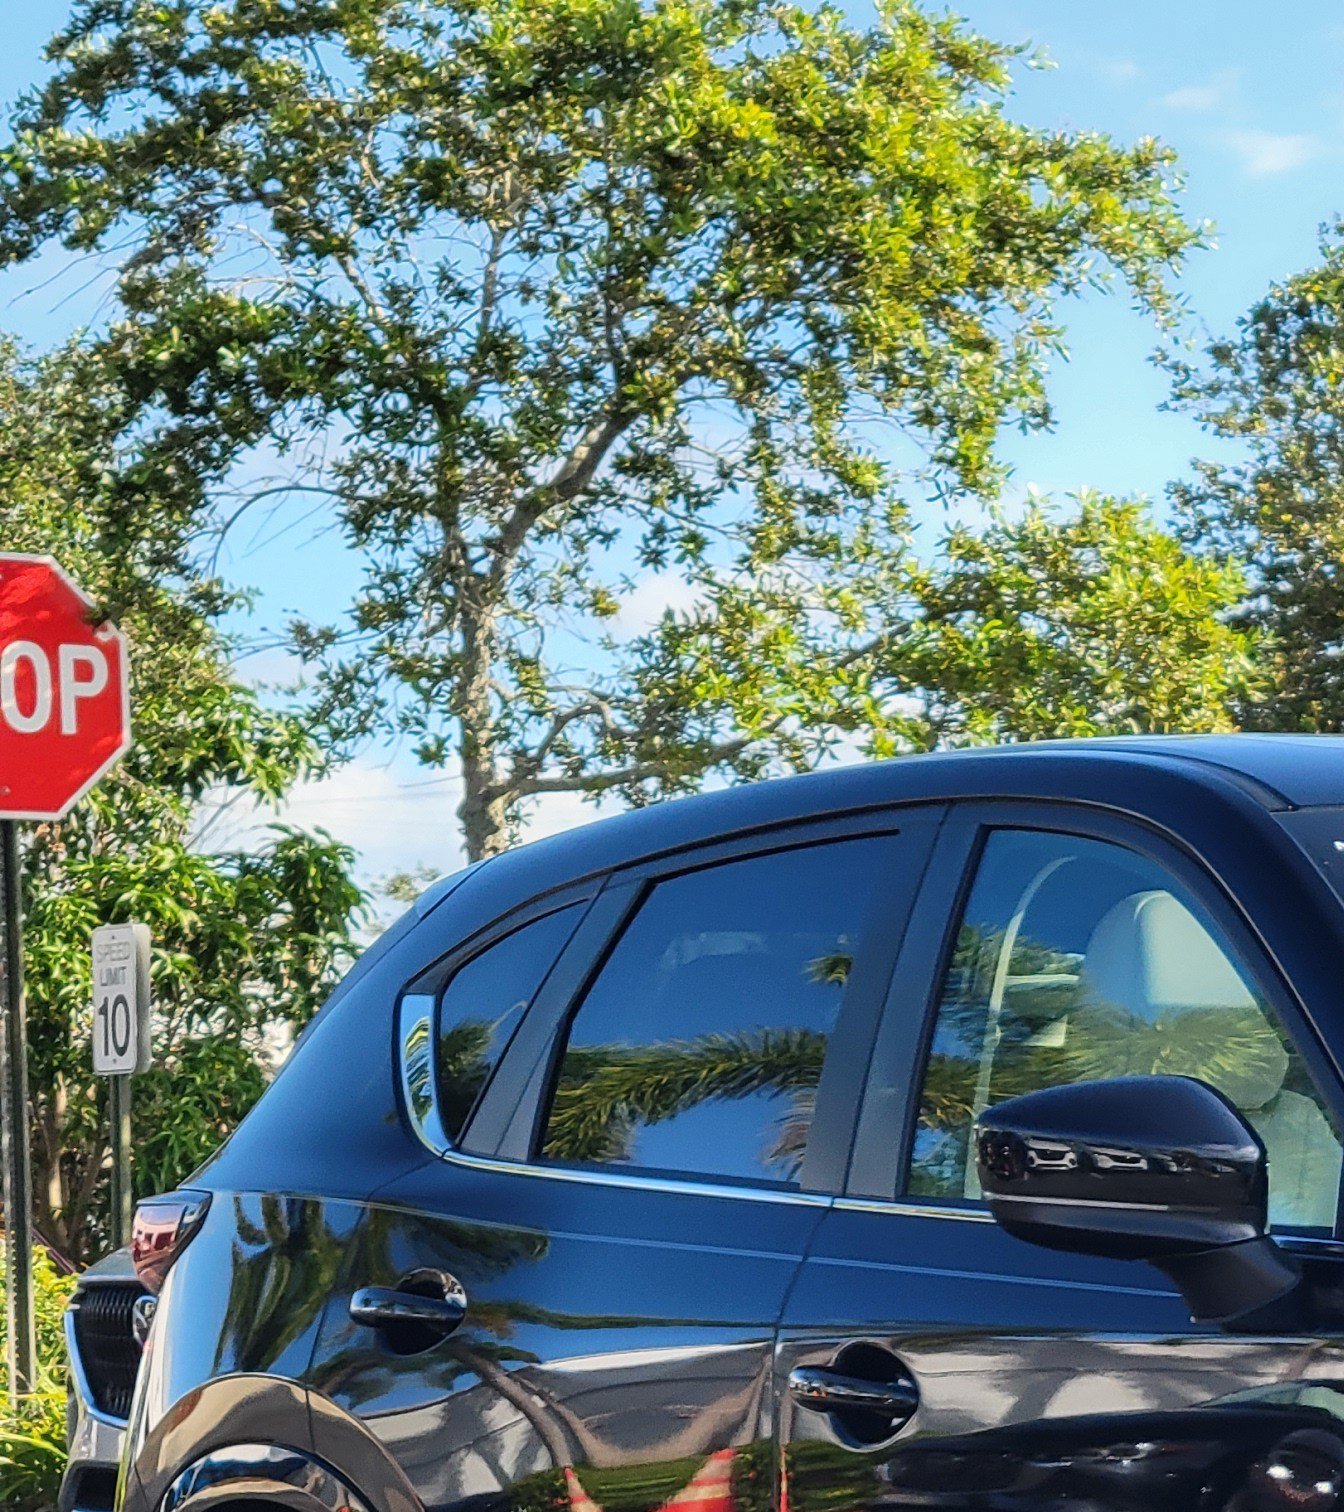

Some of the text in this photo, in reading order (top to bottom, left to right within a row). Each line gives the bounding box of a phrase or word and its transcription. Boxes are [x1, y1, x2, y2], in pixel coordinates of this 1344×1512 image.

[0, 639, 109, 736] OP
[97, 941, 130, 963] SPEED
[100, 965, 127, 987] LIMIT
[98, 993, 131, 1057] 10
